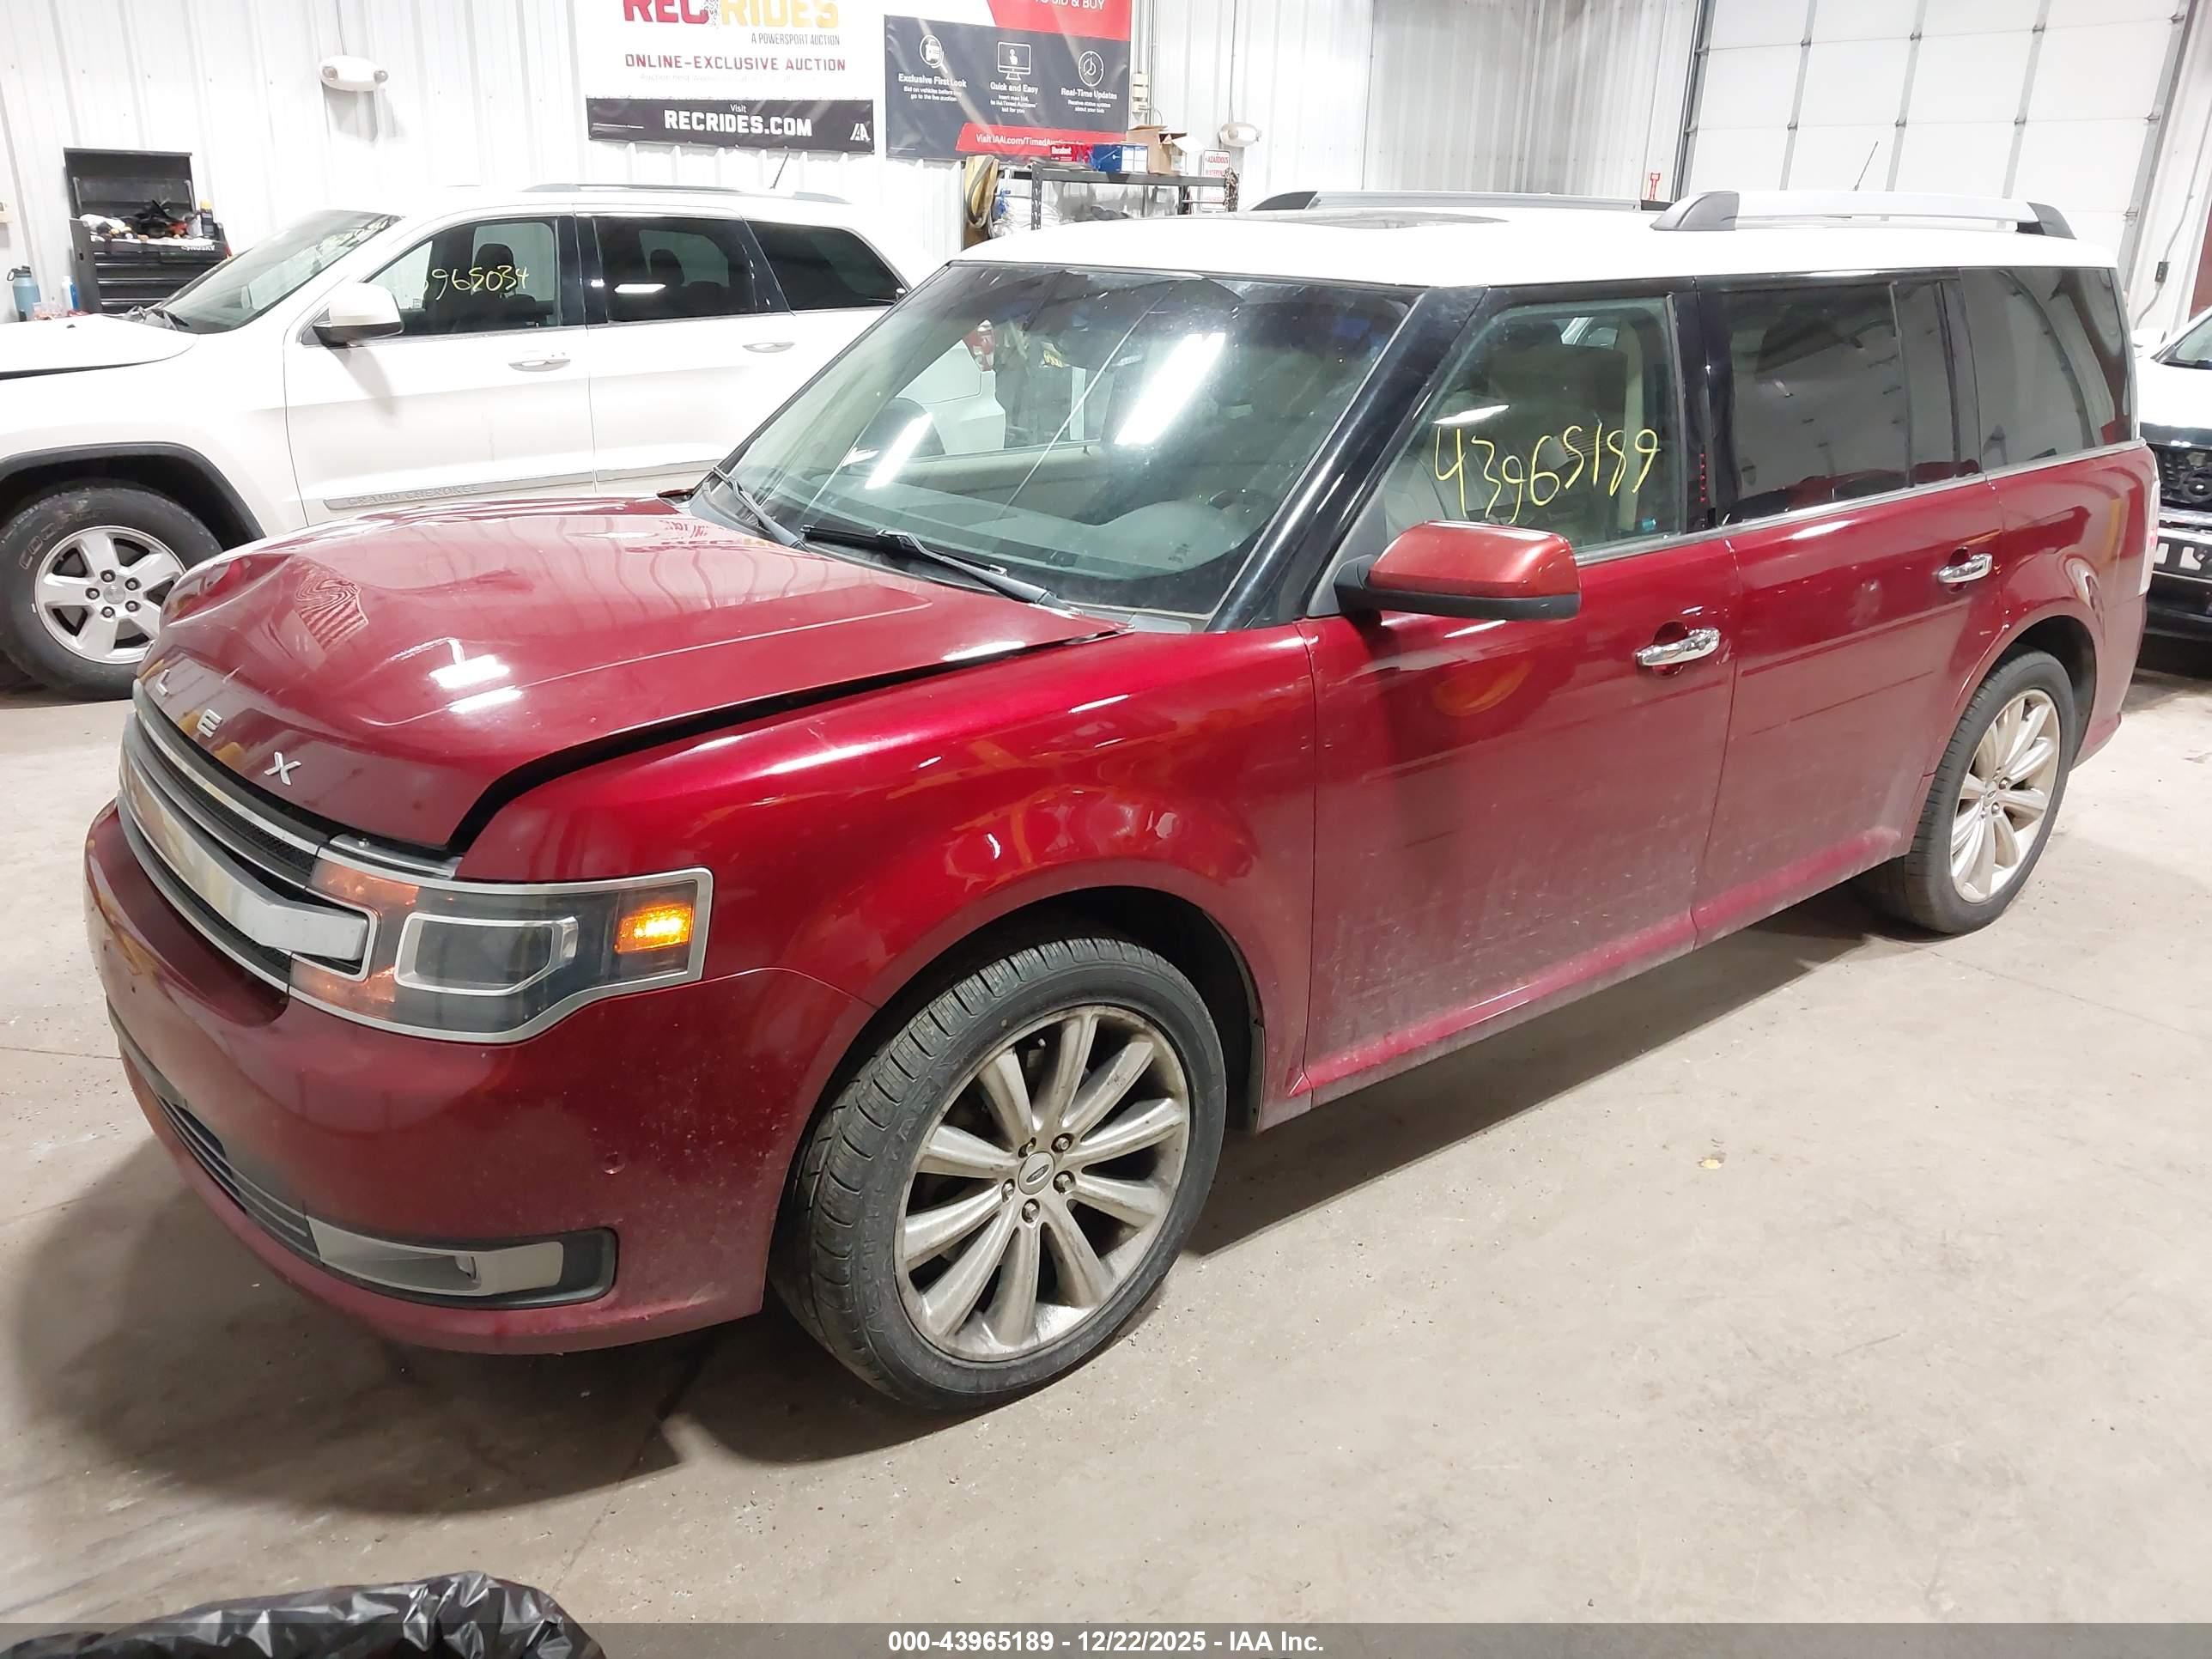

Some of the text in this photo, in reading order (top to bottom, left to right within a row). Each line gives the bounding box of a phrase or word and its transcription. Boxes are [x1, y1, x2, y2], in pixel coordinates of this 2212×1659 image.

[1082, 0, 1105, 9] BUY
[751, 33, 840, 46] A POWERSPORT AUCTION
[624, 53, 846, 71] ONLINE-EXCLUSIVE AUCTION
[898, 73, 968, 88] Exclusive First Look
[990, 82, 1038, 94] Quick and Easy
[1060, 88, 1117, 101] Real-Time Updates
[730, 103, 747, 112] Visit
[664, 109, 813, 137] RECRIDES.COM
[975, 133, 992, 143] Visit
[1435, 424, 1662, 525] 43965189
[349, 485, 480, 505] GRAND CHEROKEE
